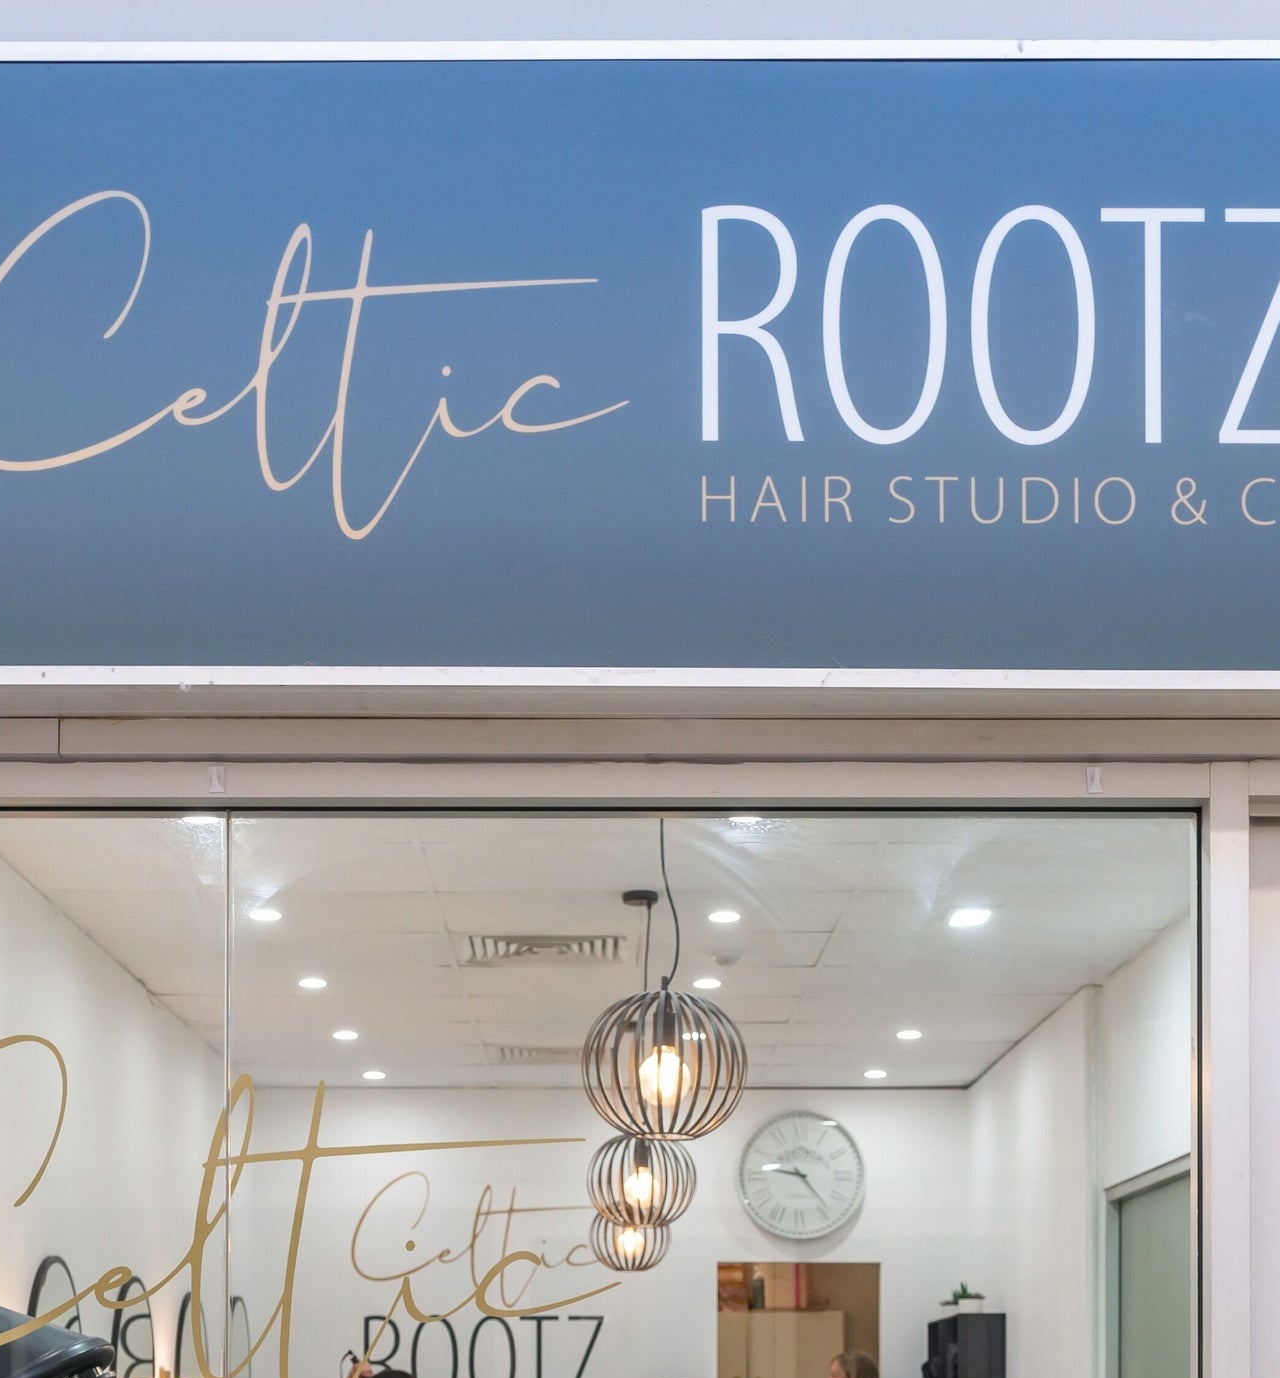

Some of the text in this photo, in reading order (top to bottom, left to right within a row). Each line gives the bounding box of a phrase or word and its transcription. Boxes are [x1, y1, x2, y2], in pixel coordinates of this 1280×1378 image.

[701, 476, 854, 525] HAIR
[888, 475, 1138, 527] STUDIO
[1170, 476, 1209, 525] &
